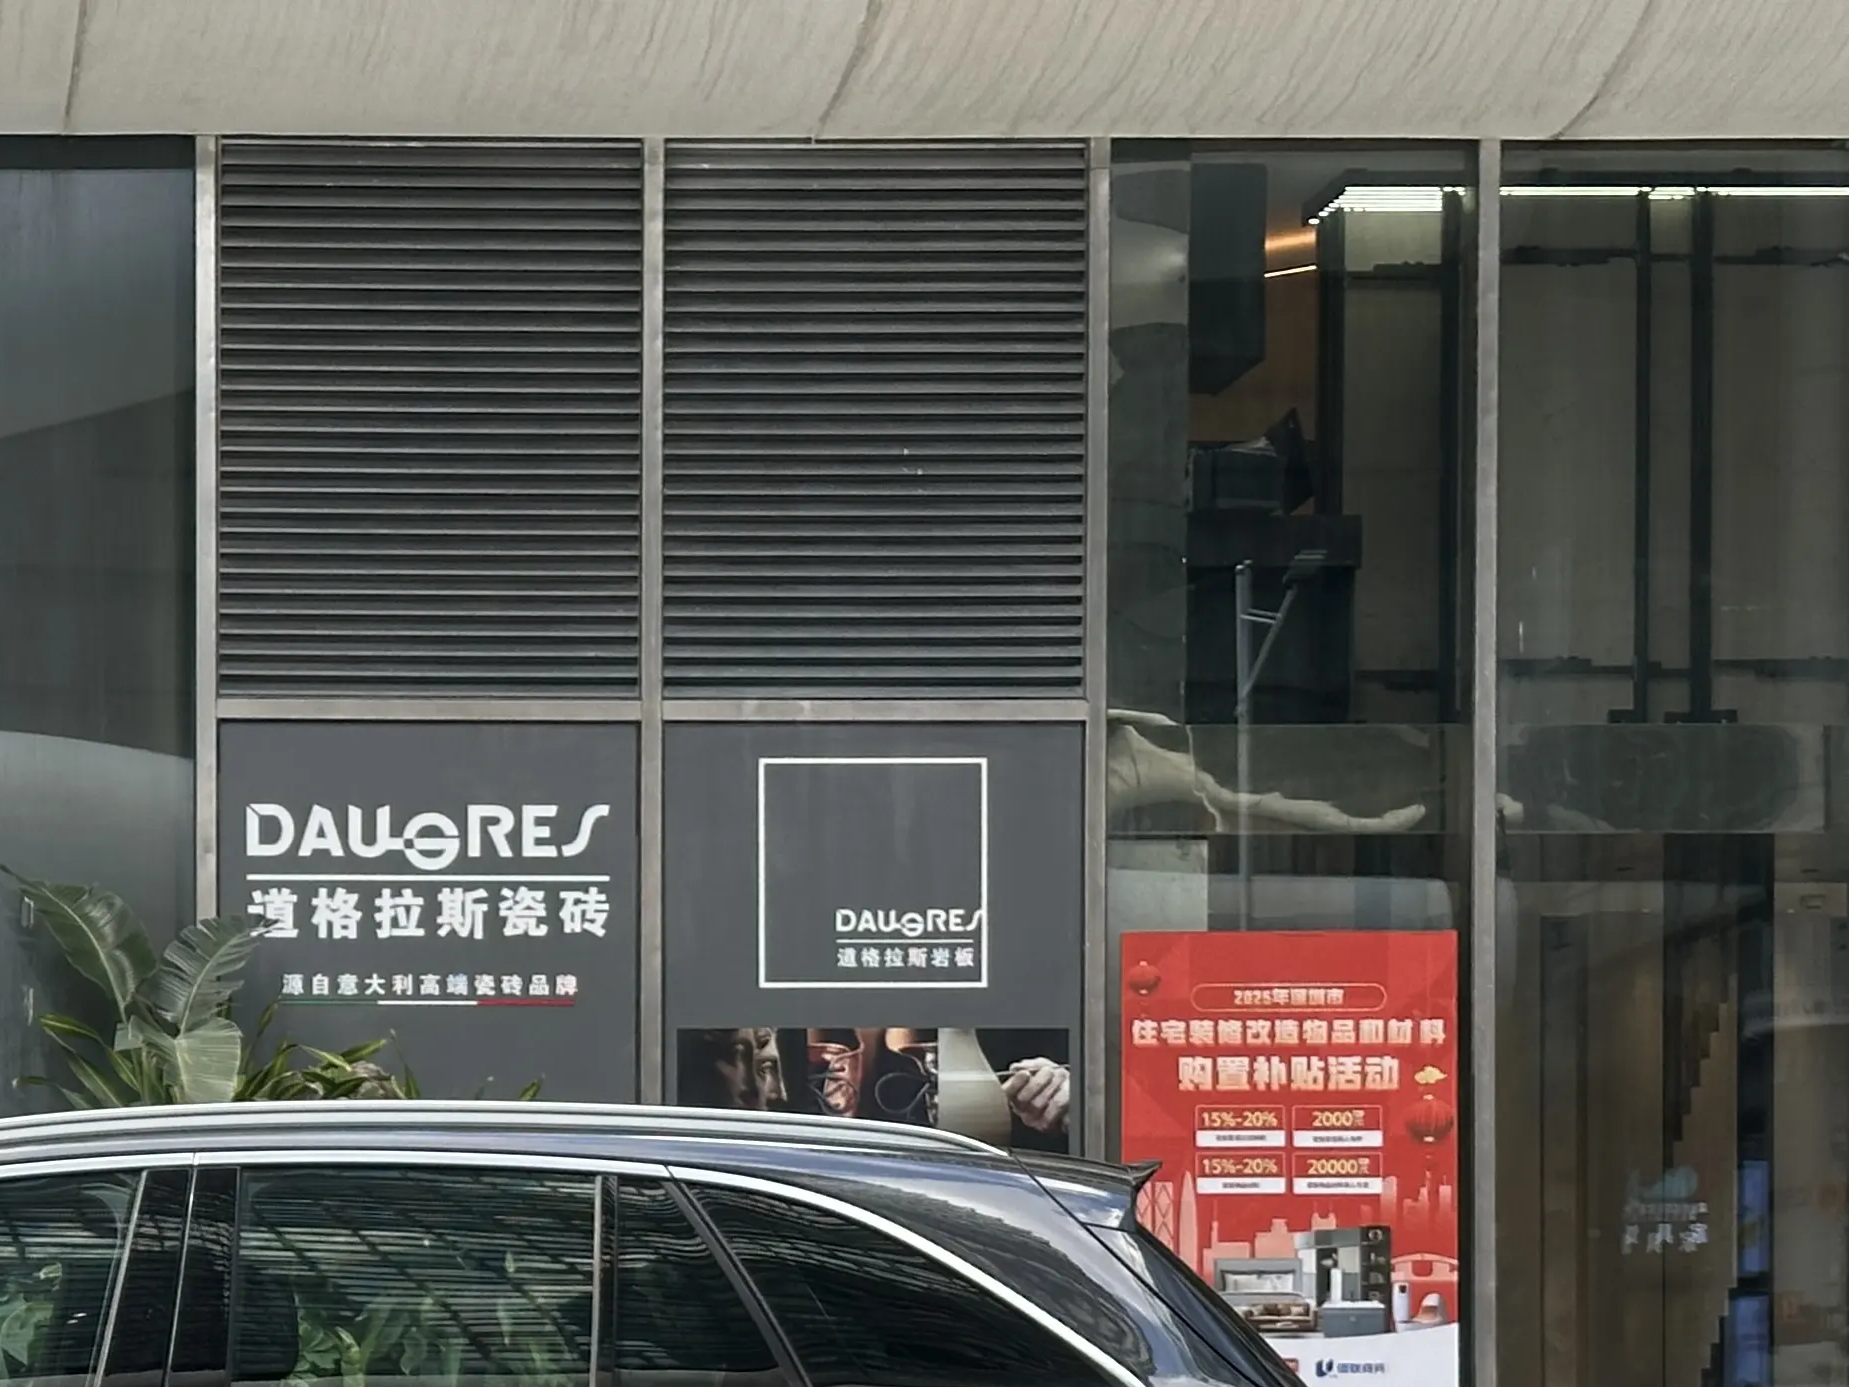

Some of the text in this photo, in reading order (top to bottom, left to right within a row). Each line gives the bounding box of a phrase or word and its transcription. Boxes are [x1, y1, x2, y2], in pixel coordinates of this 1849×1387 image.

[246, 803, 610, 870] DAUGRES
[247, 887, 610, 940] 道格拉斯瓷砖
[837, 947, 974, 968] 道格拉斯岩板
[282, 973, 578, 996] 源自意大利高端瓷砖品牌
[1178, 1056, 1400, 1091] 购置补贴活动
[1202, 1111, 1278, 1127] 15%-20%
[1202, 1158, 1278, 1174] 15%-20%
